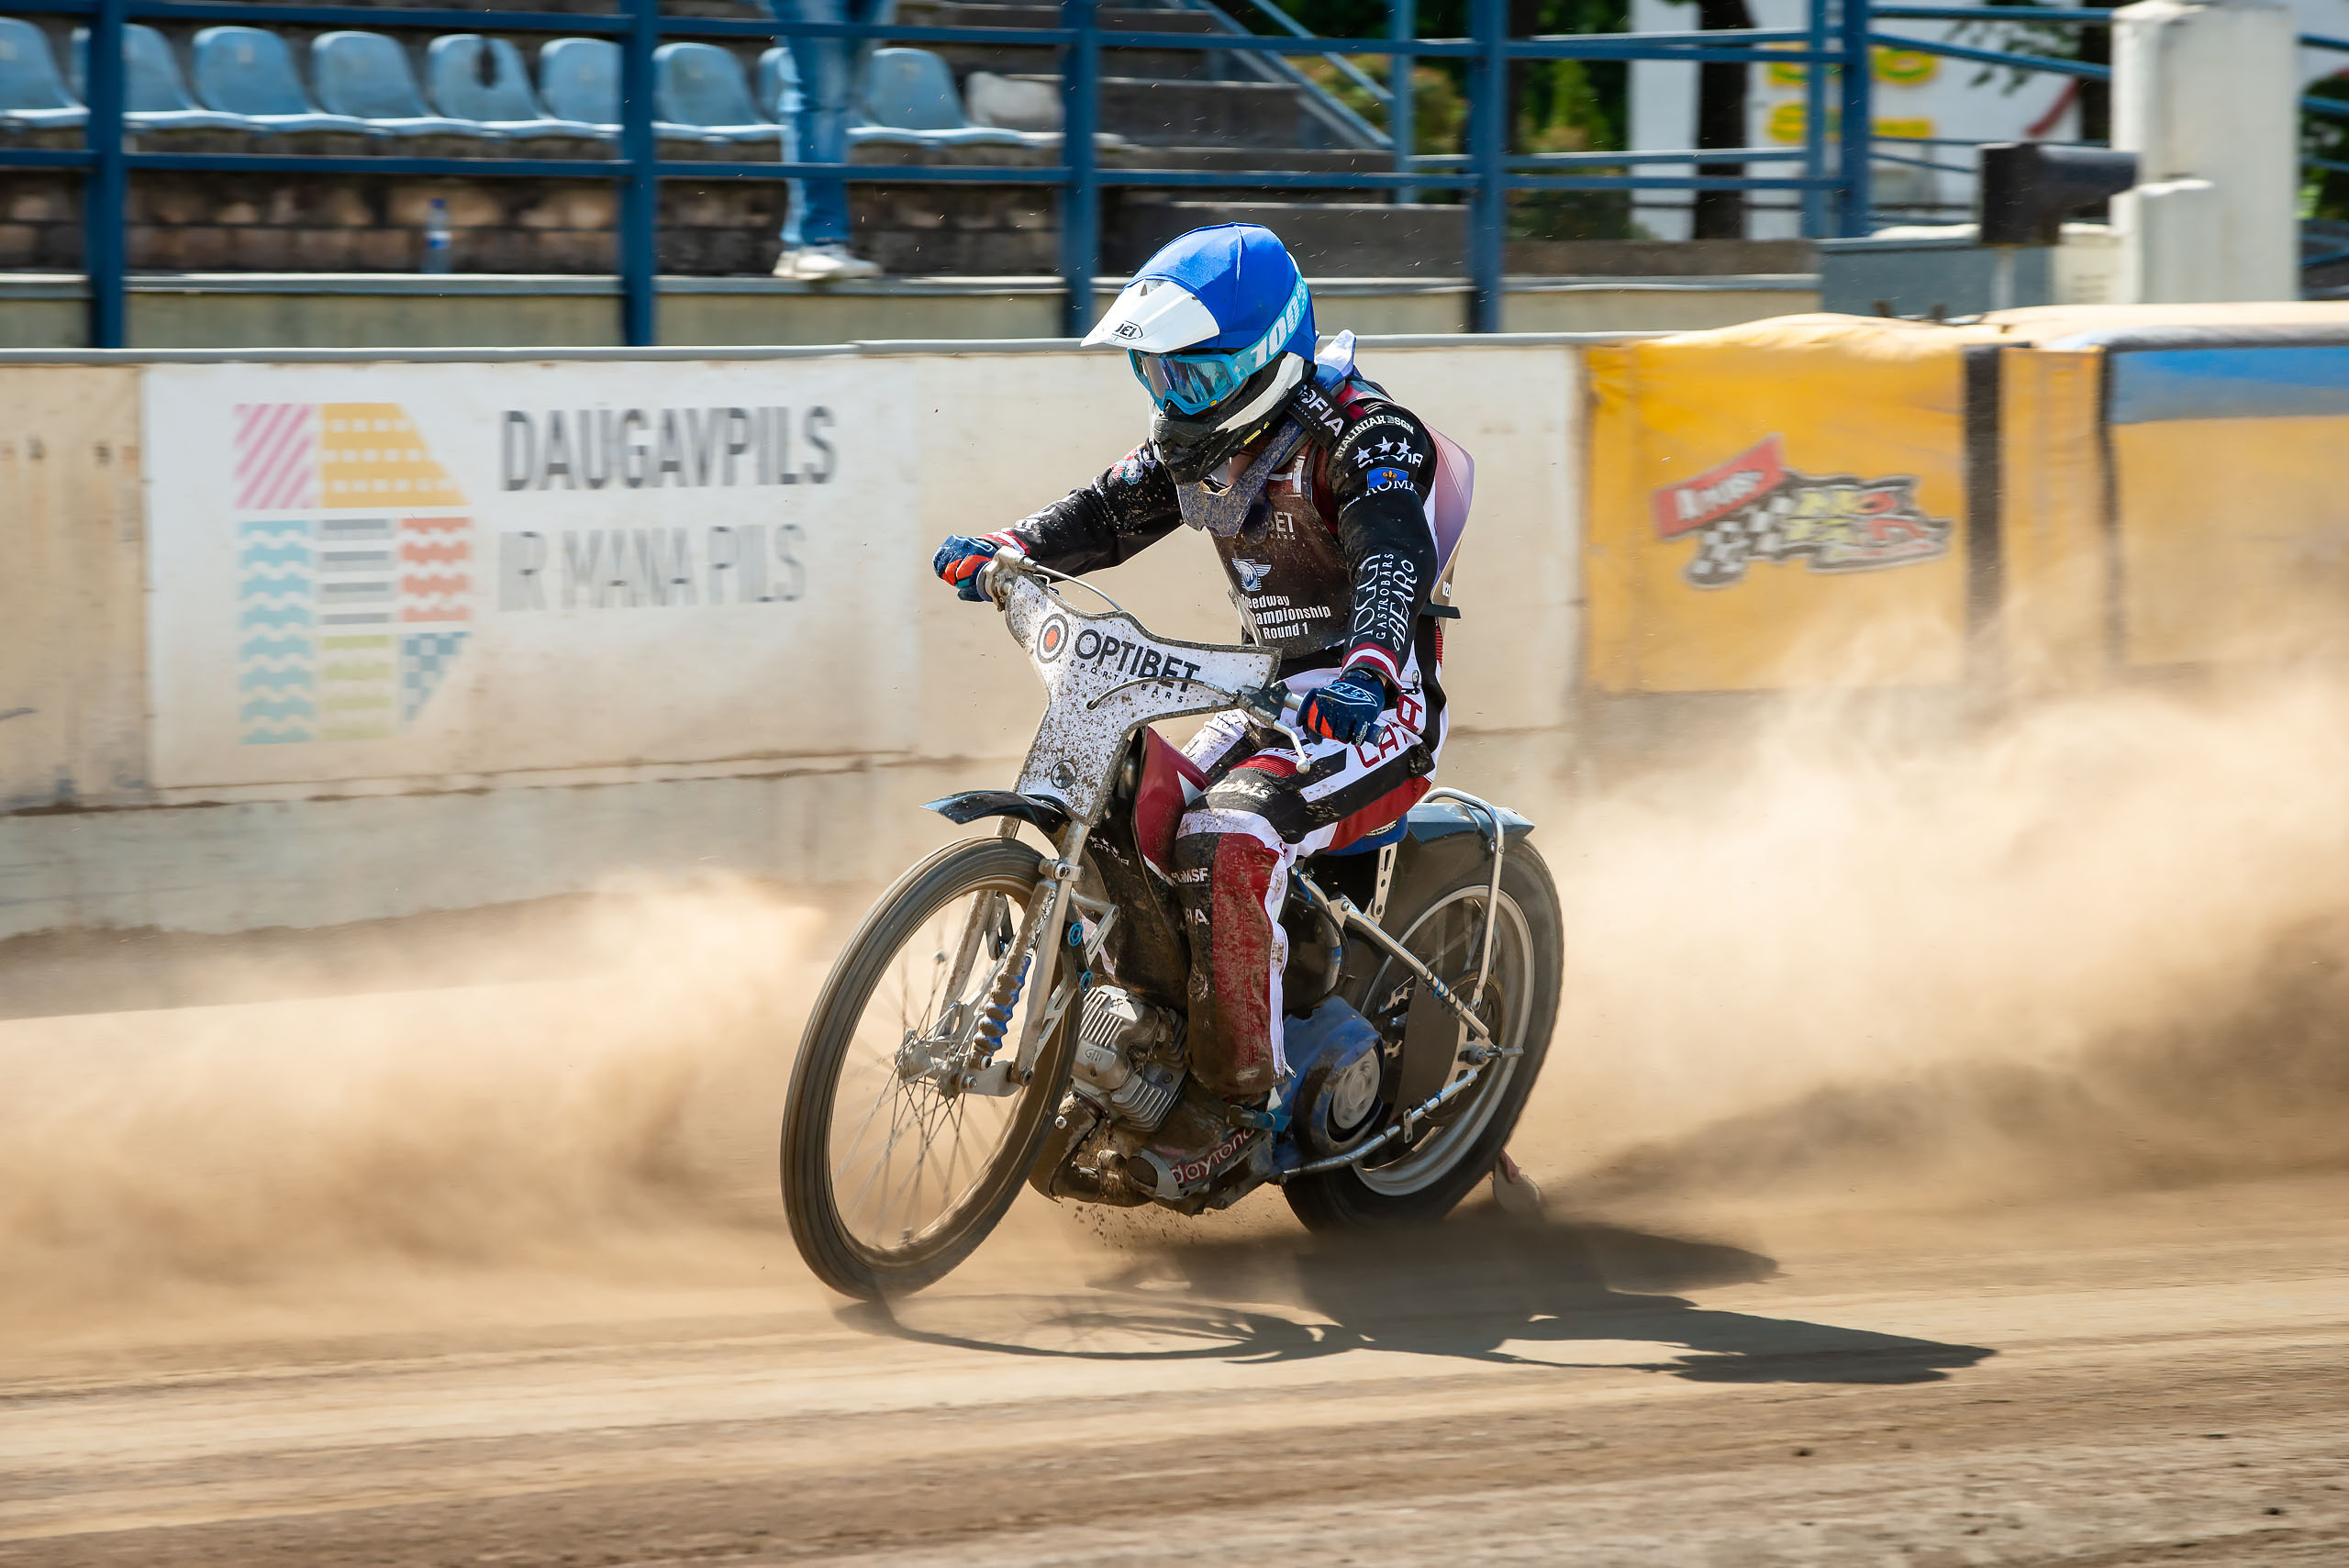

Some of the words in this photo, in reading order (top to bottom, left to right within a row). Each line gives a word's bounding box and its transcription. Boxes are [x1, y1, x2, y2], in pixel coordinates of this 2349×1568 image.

[500, 406, 837, 491] DAUGAVPILS
[707, 523, 807, 606] PILS
[1074, 628, 1201, 693] OPTIBET
[1263, 623, 1302, 639] Round
[1302, 621, 1309, 635] 1
